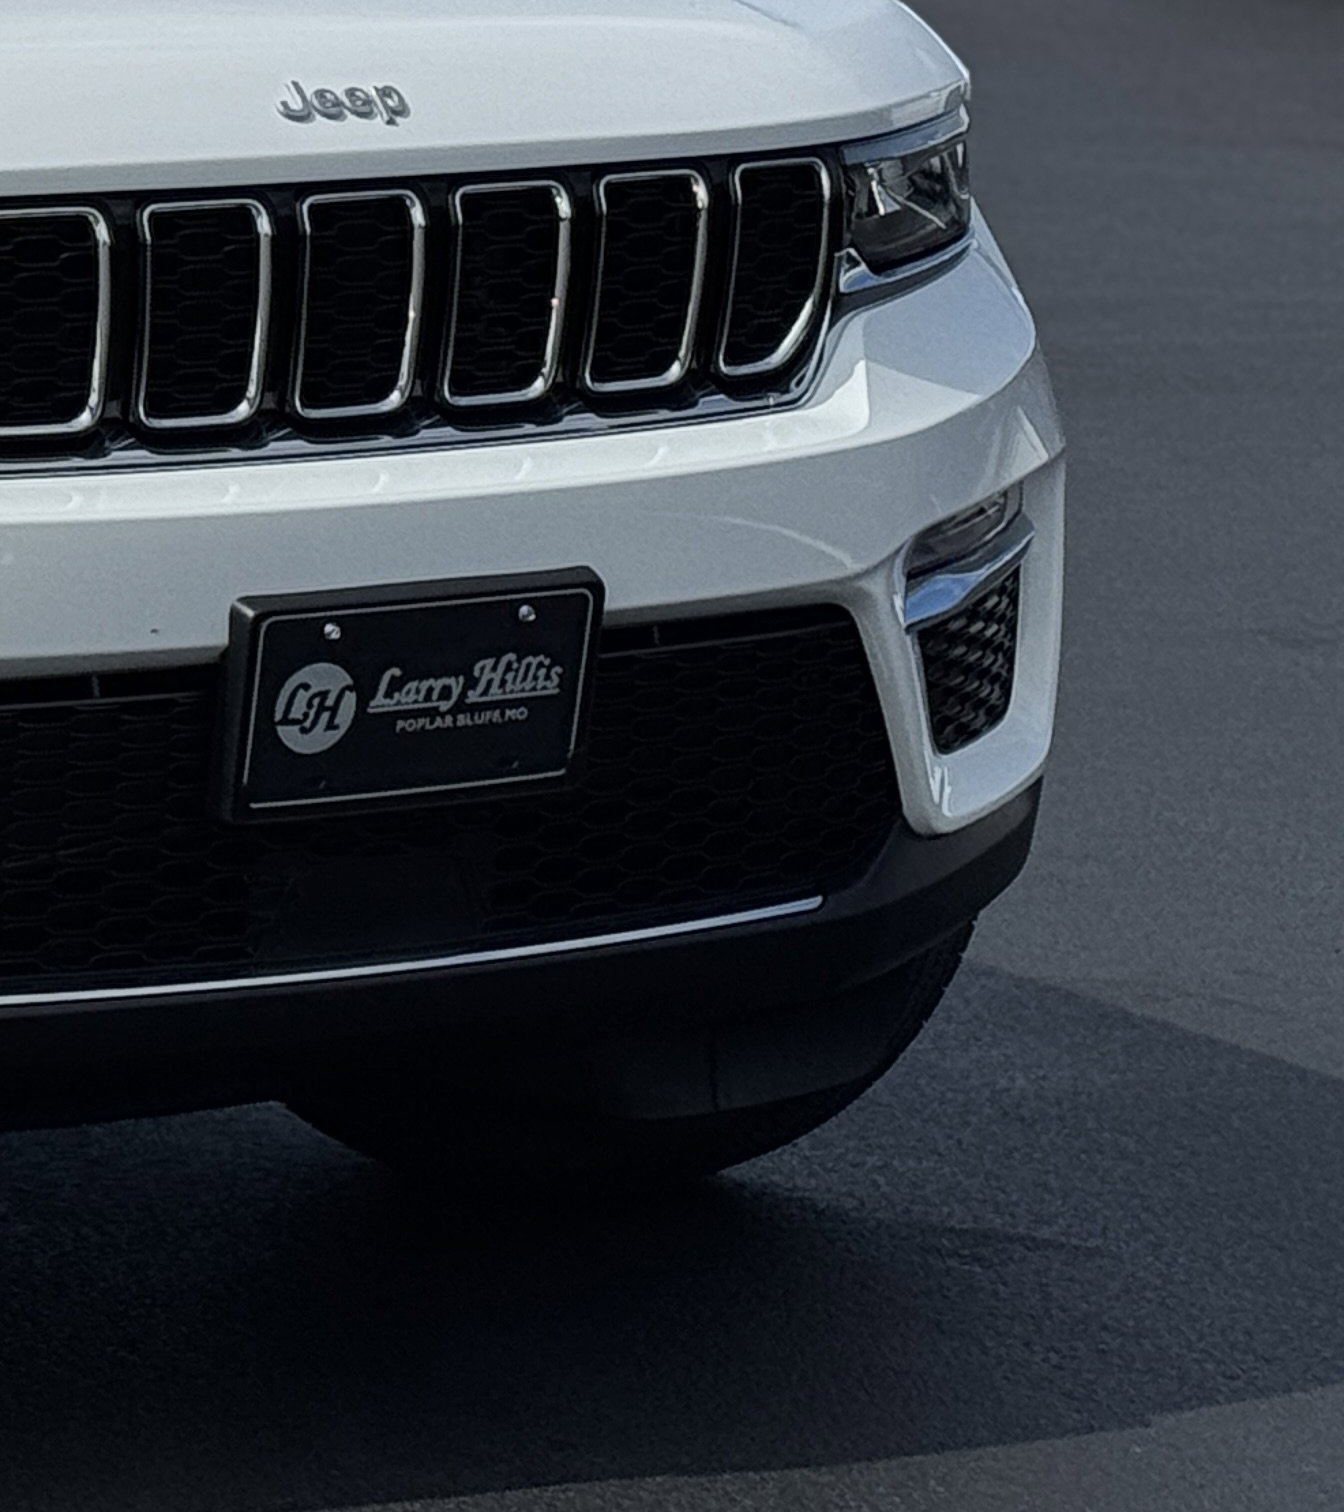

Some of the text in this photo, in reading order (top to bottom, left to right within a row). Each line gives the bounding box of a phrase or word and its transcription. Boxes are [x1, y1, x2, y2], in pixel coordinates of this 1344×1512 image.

[275, 80, 411, 127] Jeep
[368, 652, 563, 713] Larry Hillis
[395, 714, 454, 733] POPLAR
